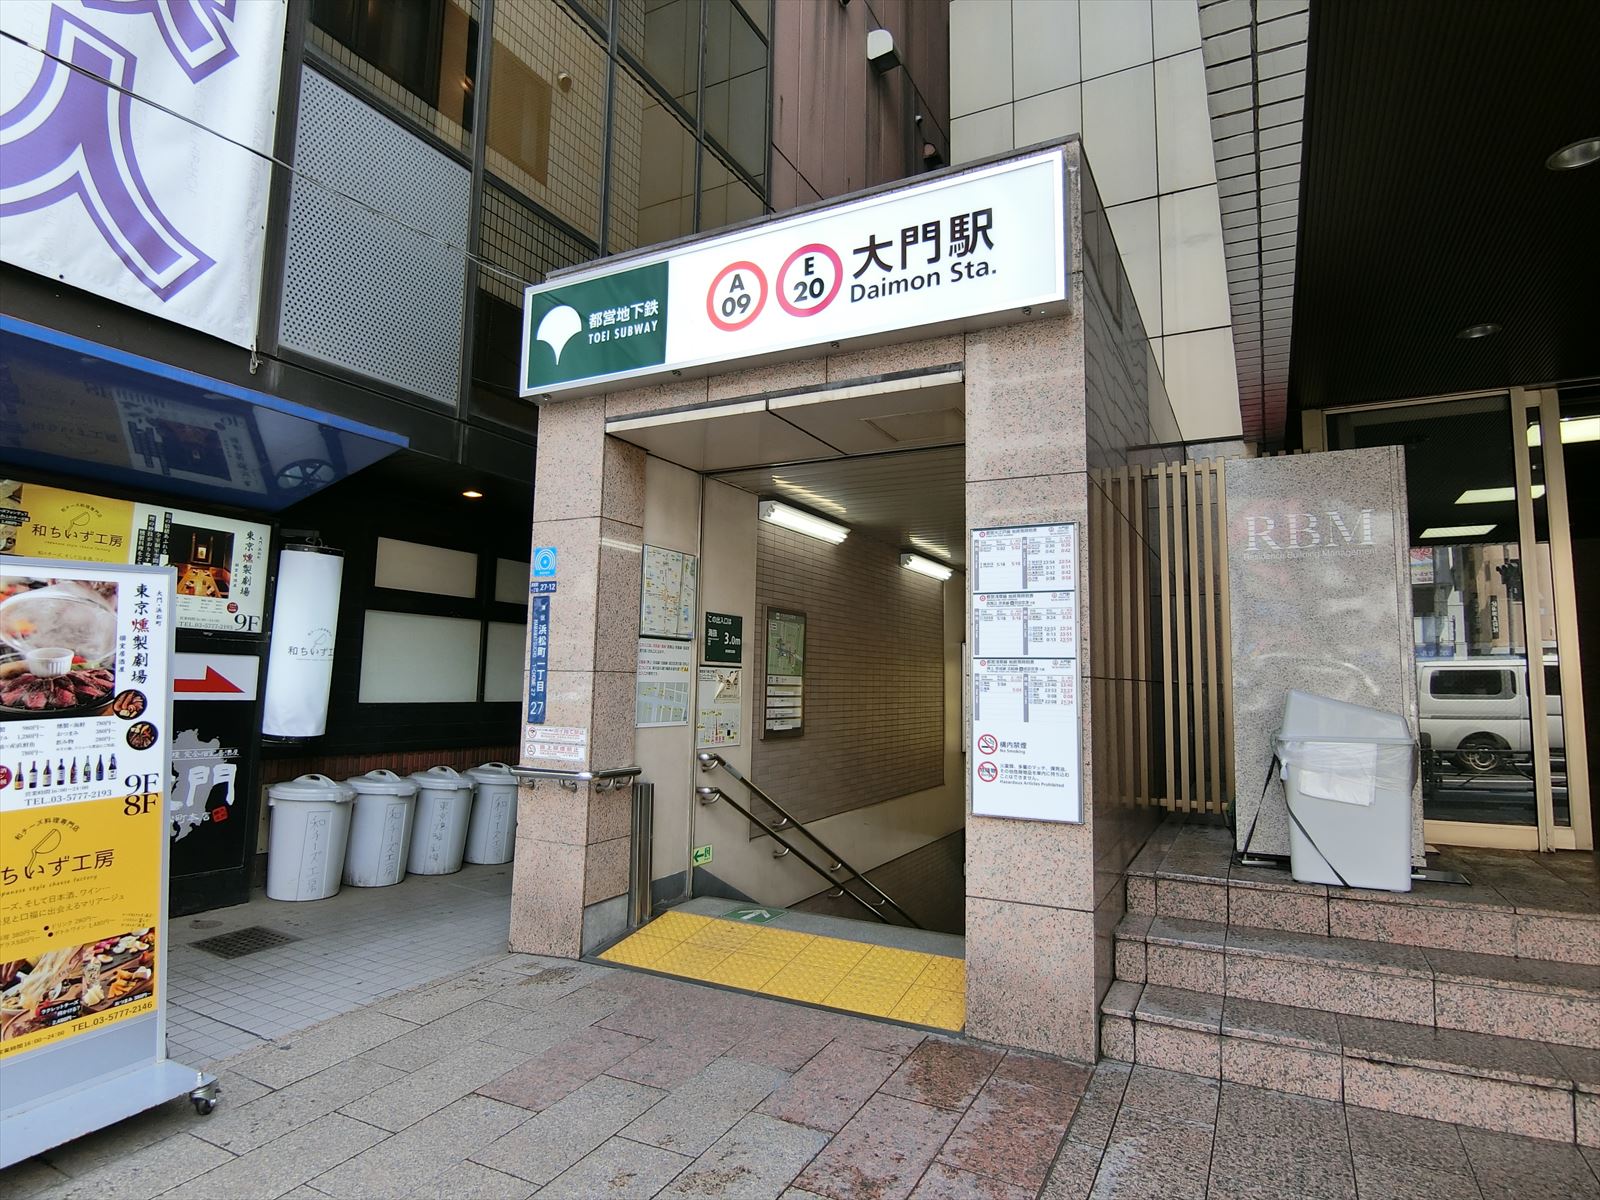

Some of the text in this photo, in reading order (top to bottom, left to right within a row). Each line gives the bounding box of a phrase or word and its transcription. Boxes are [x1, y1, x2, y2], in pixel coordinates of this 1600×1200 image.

[852, 207, 995, 280] 大門駅
[804, 256, 815, 276] E
[729, 274, 745, 294] A
[793, 277, 825, 303] 20
[850, 260, 997, 303] Daimon Sta.
[589, 299, 659, 329] 都営地下鉄
[721, 294, 752, 318] 09
[588, 320, 659, 345] TOEI SUBWAY
[32, 523, 123, 548] 和ちいず工房
[1245, 508, 1377, 551] RBM
[240, 530, 255, 597] 東京燻製劇場
[131, 583, 150, 685] 東京燻製劇場
[234, 613, 261, 632] 9F
[538, 624, 547, 658] 浜松町
[724, 632, 741, 646] 3.0m
[536, 662, 546, 692] 一丁目
[530, 702, 544, 715] 27
[1000, 741, 1027, 750] 構内禁煙
[124, 773, 160, 796] 9F
[24, 790, 112, 807] TEL.03-5777-2193
[124, 793, 159, 816] 8F
[14, 817, 80, 841] 和チーズ料理専門店
[72, 1002, 153, 1033] TEL.03-5777-2146
